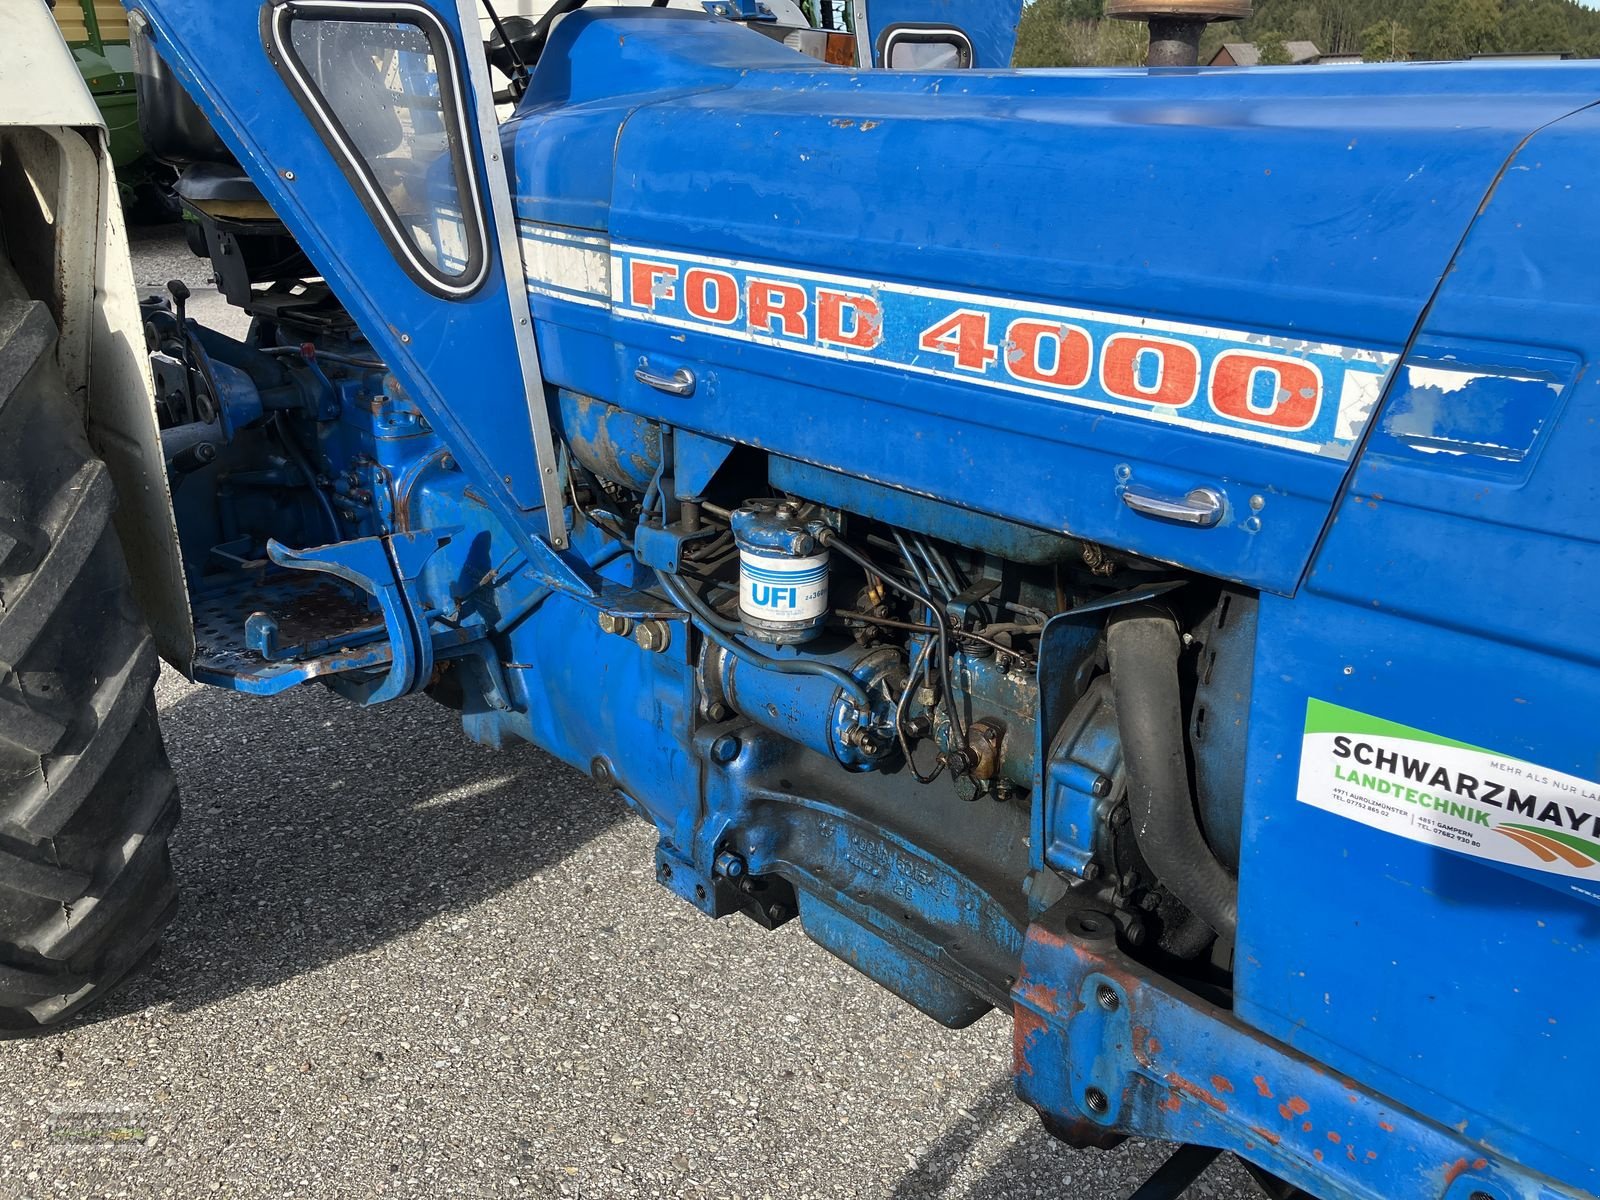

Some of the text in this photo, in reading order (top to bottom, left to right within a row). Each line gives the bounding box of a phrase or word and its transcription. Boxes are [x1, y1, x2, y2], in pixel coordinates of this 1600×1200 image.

[630, 258, 1324, 431] FORD 4000
[752, 583, 797, 608] UFI
[1490, 761, 1522, 776] MEHR
[1526, 773, 1549, 785] ALS
[1553, 781, 1577, 794] NUR
[1334, 765, 1492, 828] LANDTECHNIK
[1346, 798, 1366, 809] 07752
[1350, 793, 1409, 816] AUROLZMÜNSTER
[1418, 816, 1473, 838] 4851 GAMPERN
[1456, 835, 1470, 844] 930
[1471, 840, 1481, 848] 80
